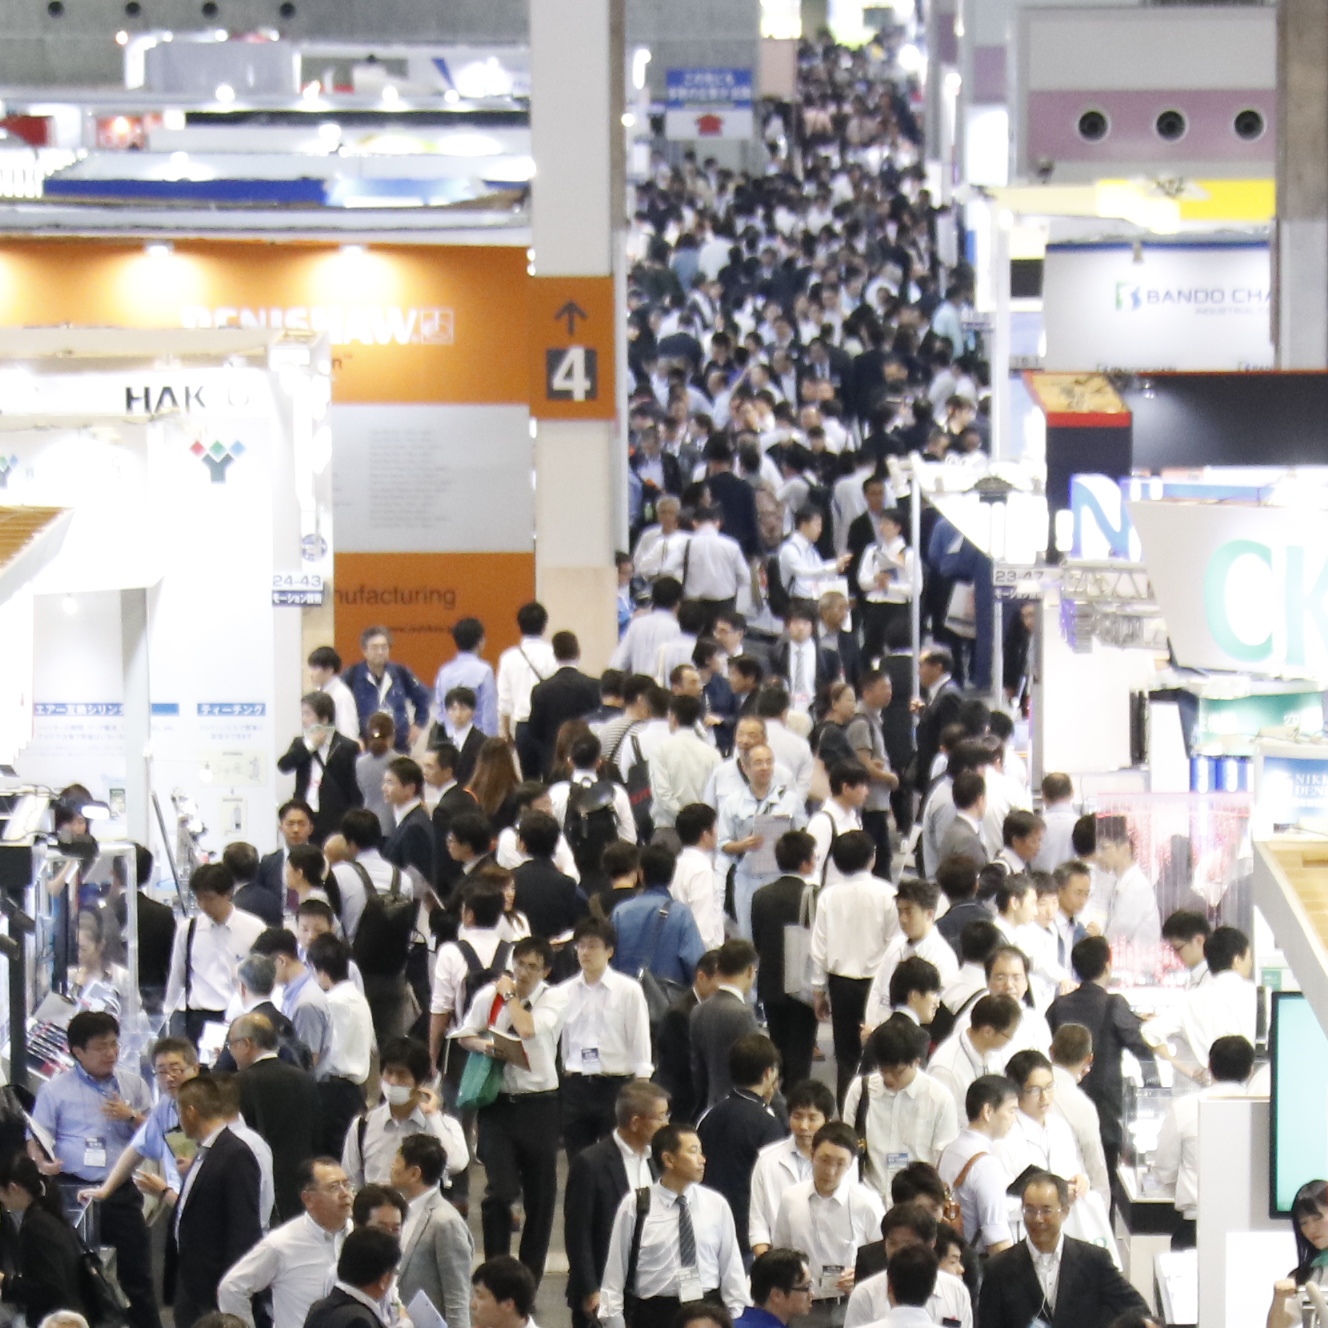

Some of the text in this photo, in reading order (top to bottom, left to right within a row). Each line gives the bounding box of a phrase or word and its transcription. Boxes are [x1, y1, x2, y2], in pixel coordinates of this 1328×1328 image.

[1147, 288, 1271, 305] BANDO CHA
[552, 346, 592, 401] 4
[272, 574, 322, 588] 24-43
[333, 585, 457, 610] nufacturing
